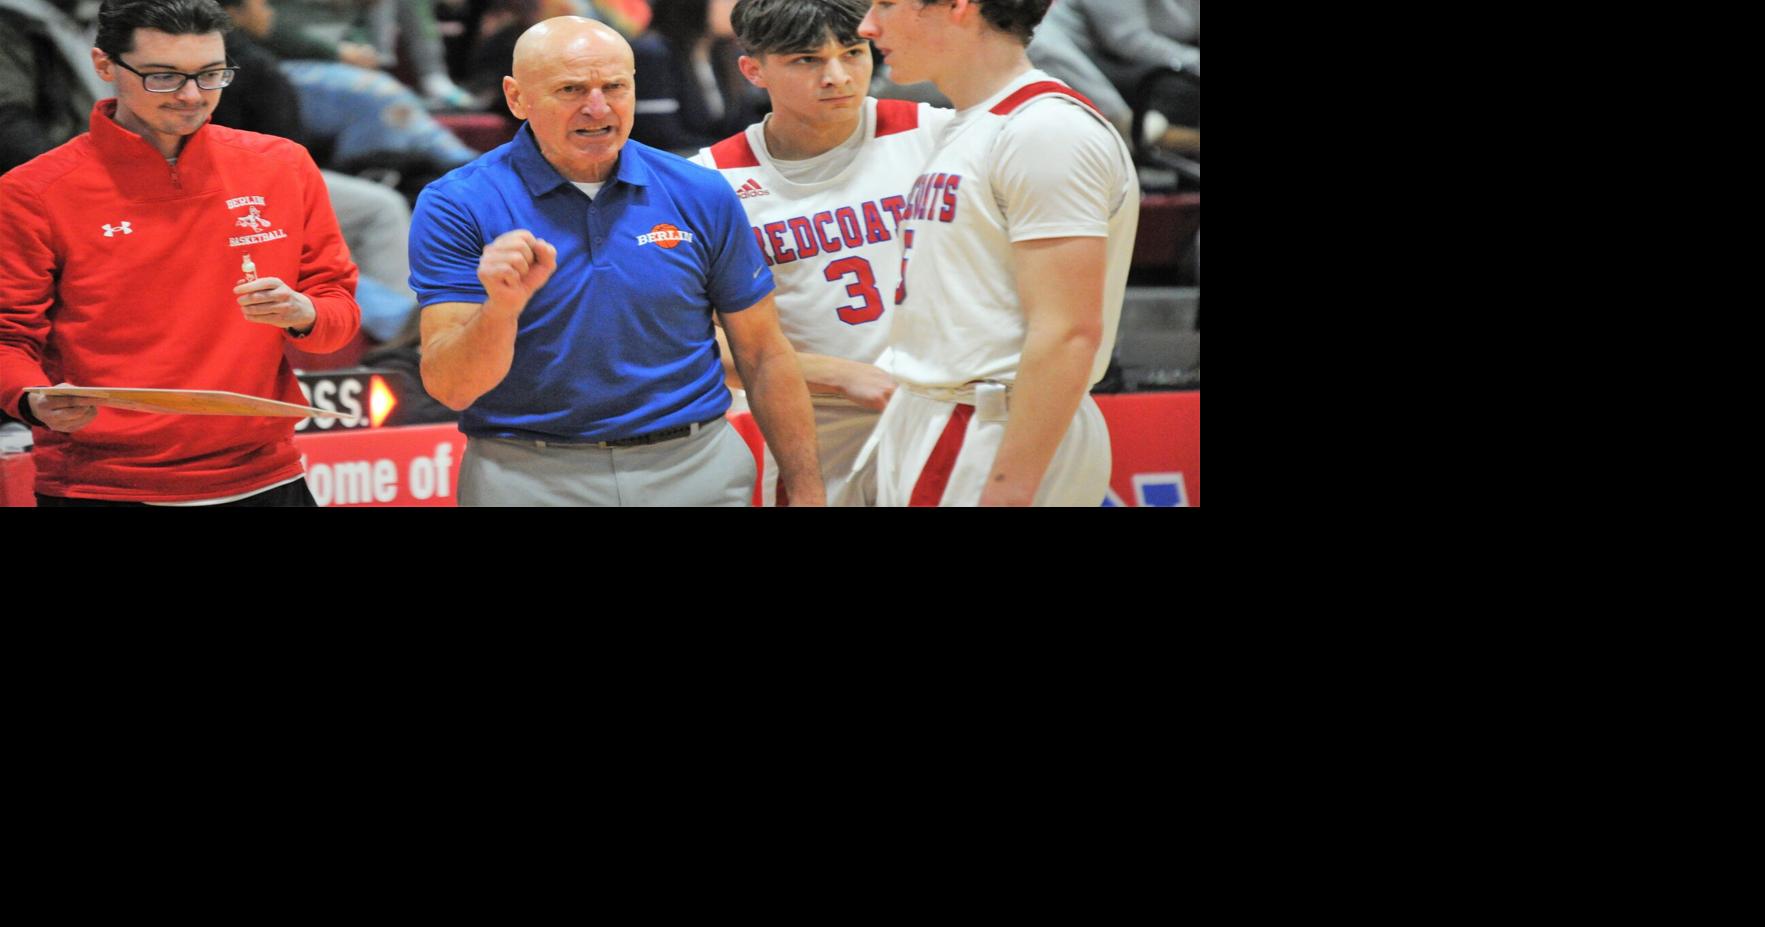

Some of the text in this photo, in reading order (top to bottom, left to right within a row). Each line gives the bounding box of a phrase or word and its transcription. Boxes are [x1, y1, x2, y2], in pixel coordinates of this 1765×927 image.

[225, 195, 266, 209] BERLIN
[737, 189, 770, 199] didas
[228, 228, 288, 247] BASKETBALL
[636, 230, 693, 246] BERLIN
[823, 255, 885, 326] 3
[301, 442, 453, 506] ome of
